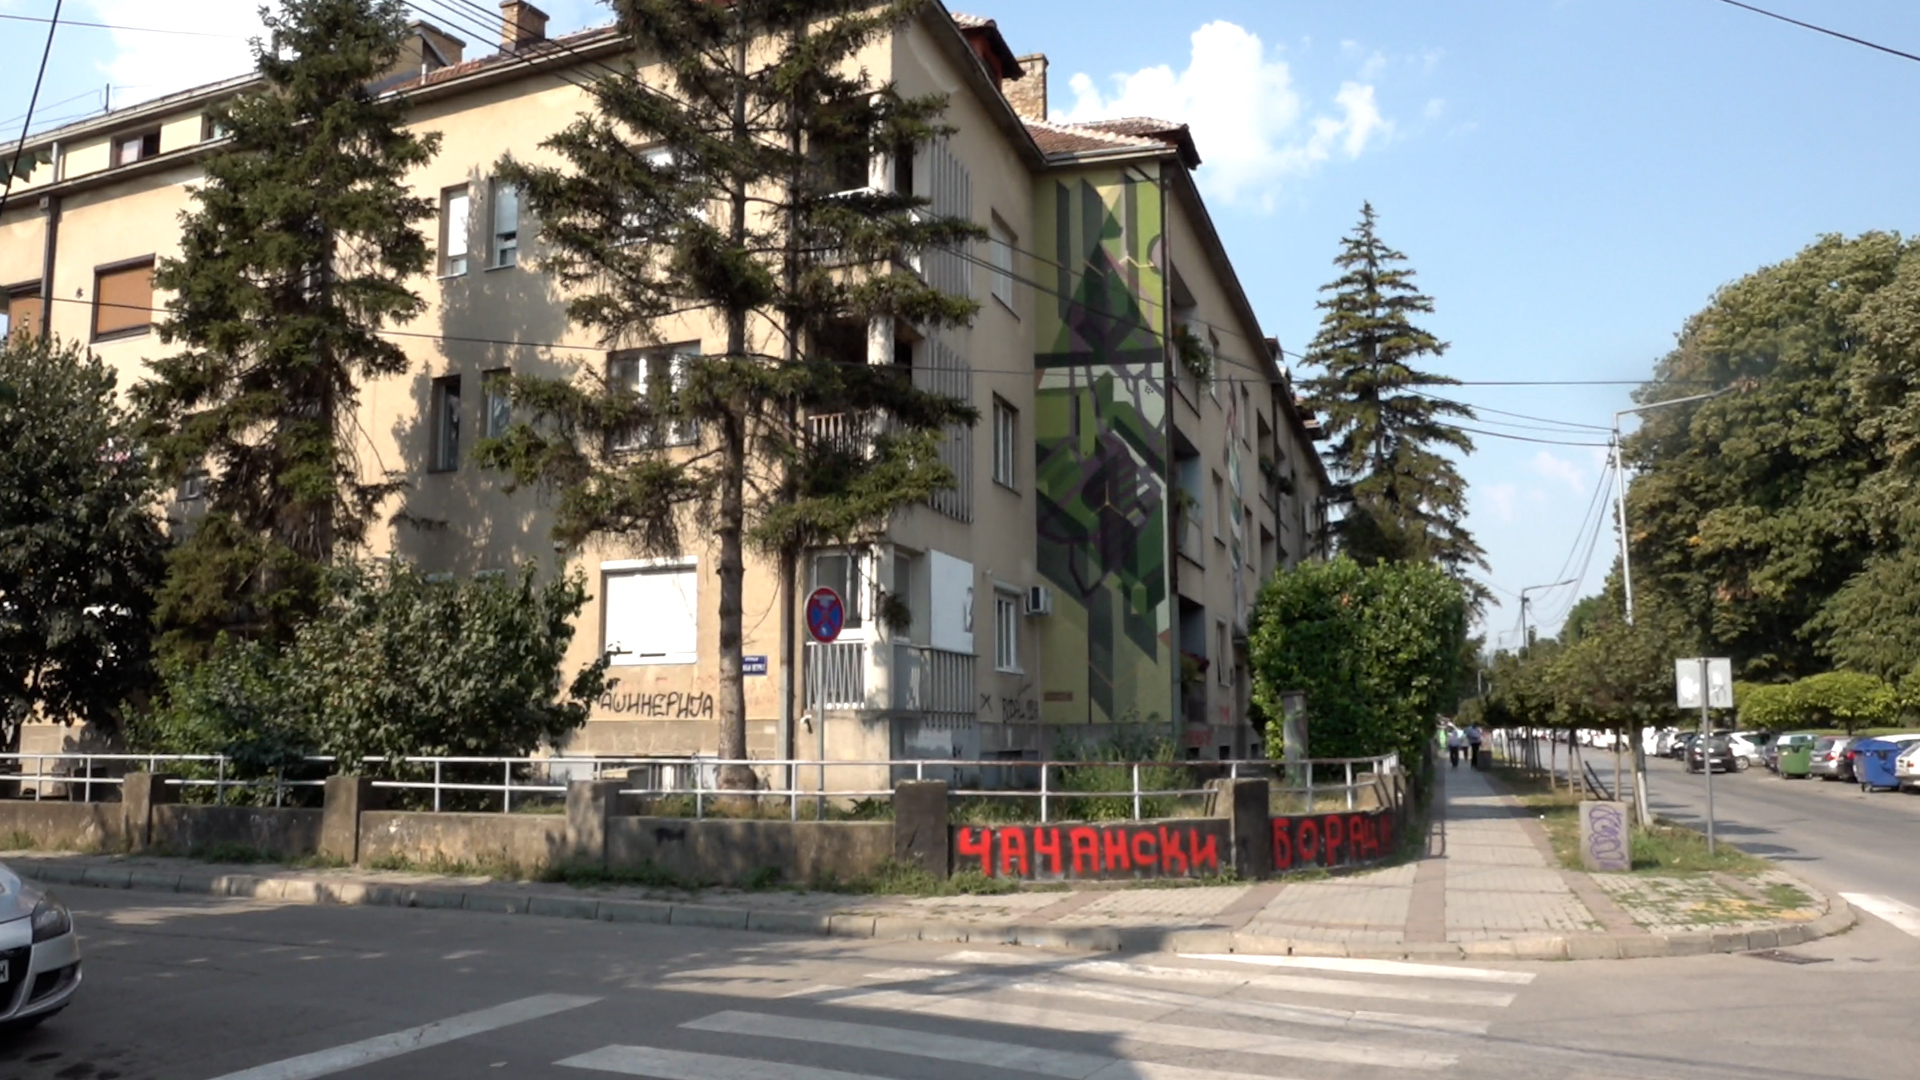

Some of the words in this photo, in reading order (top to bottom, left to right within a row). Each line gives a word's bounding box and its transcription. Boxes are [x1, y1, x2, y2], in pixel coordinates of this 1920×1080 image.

[597, 690, 714, 719] АШИНЕРИЈА
[957, 825, 1218, 876] ЧАЧАНСКИ
[1272, 813, 1393, 869] БОРАЦ
